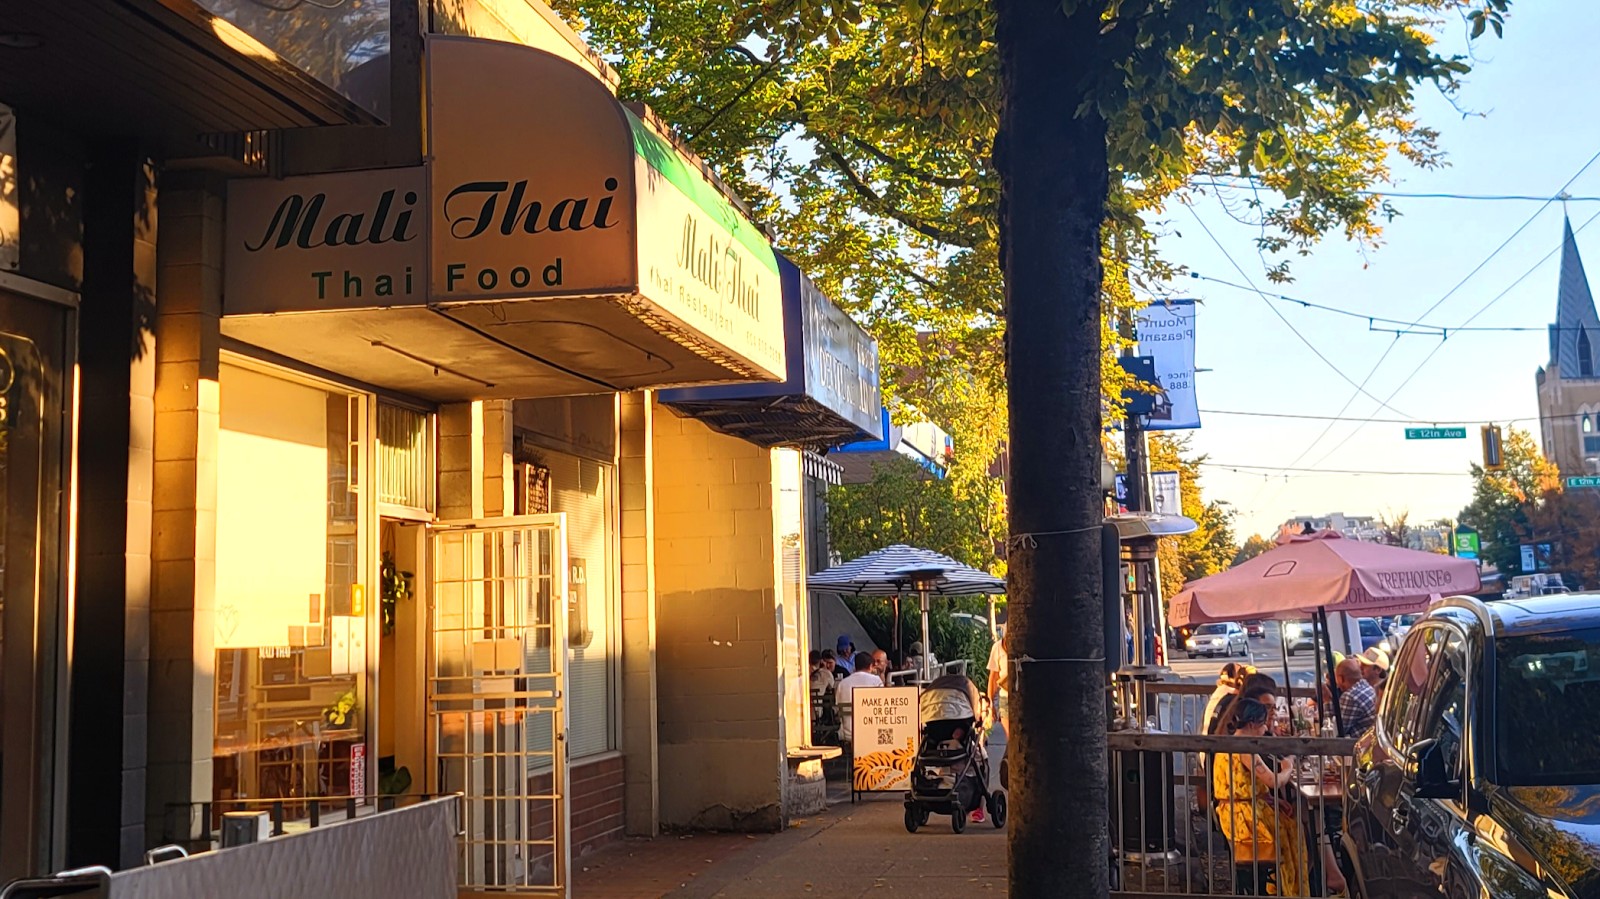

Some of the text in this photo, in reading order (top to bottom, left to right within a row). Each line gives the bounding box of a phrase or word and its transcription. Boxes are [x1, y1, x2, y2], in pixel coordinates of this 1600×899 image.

[244, 177, 620, 251] Mali Thai
[676, 213, 759, 322] Mali Thai
[311, 258, 562, 299] Thai Food
[1409, 430, 1416, 438] E
[1443, 429, 1462, 437] Ave
[861, 698, 909, 706] MAKE A RESO
[873, 707, 897, 716] OR GET
[863, 717, 873, 725] ON
[875, 716, 888, 724] THE
